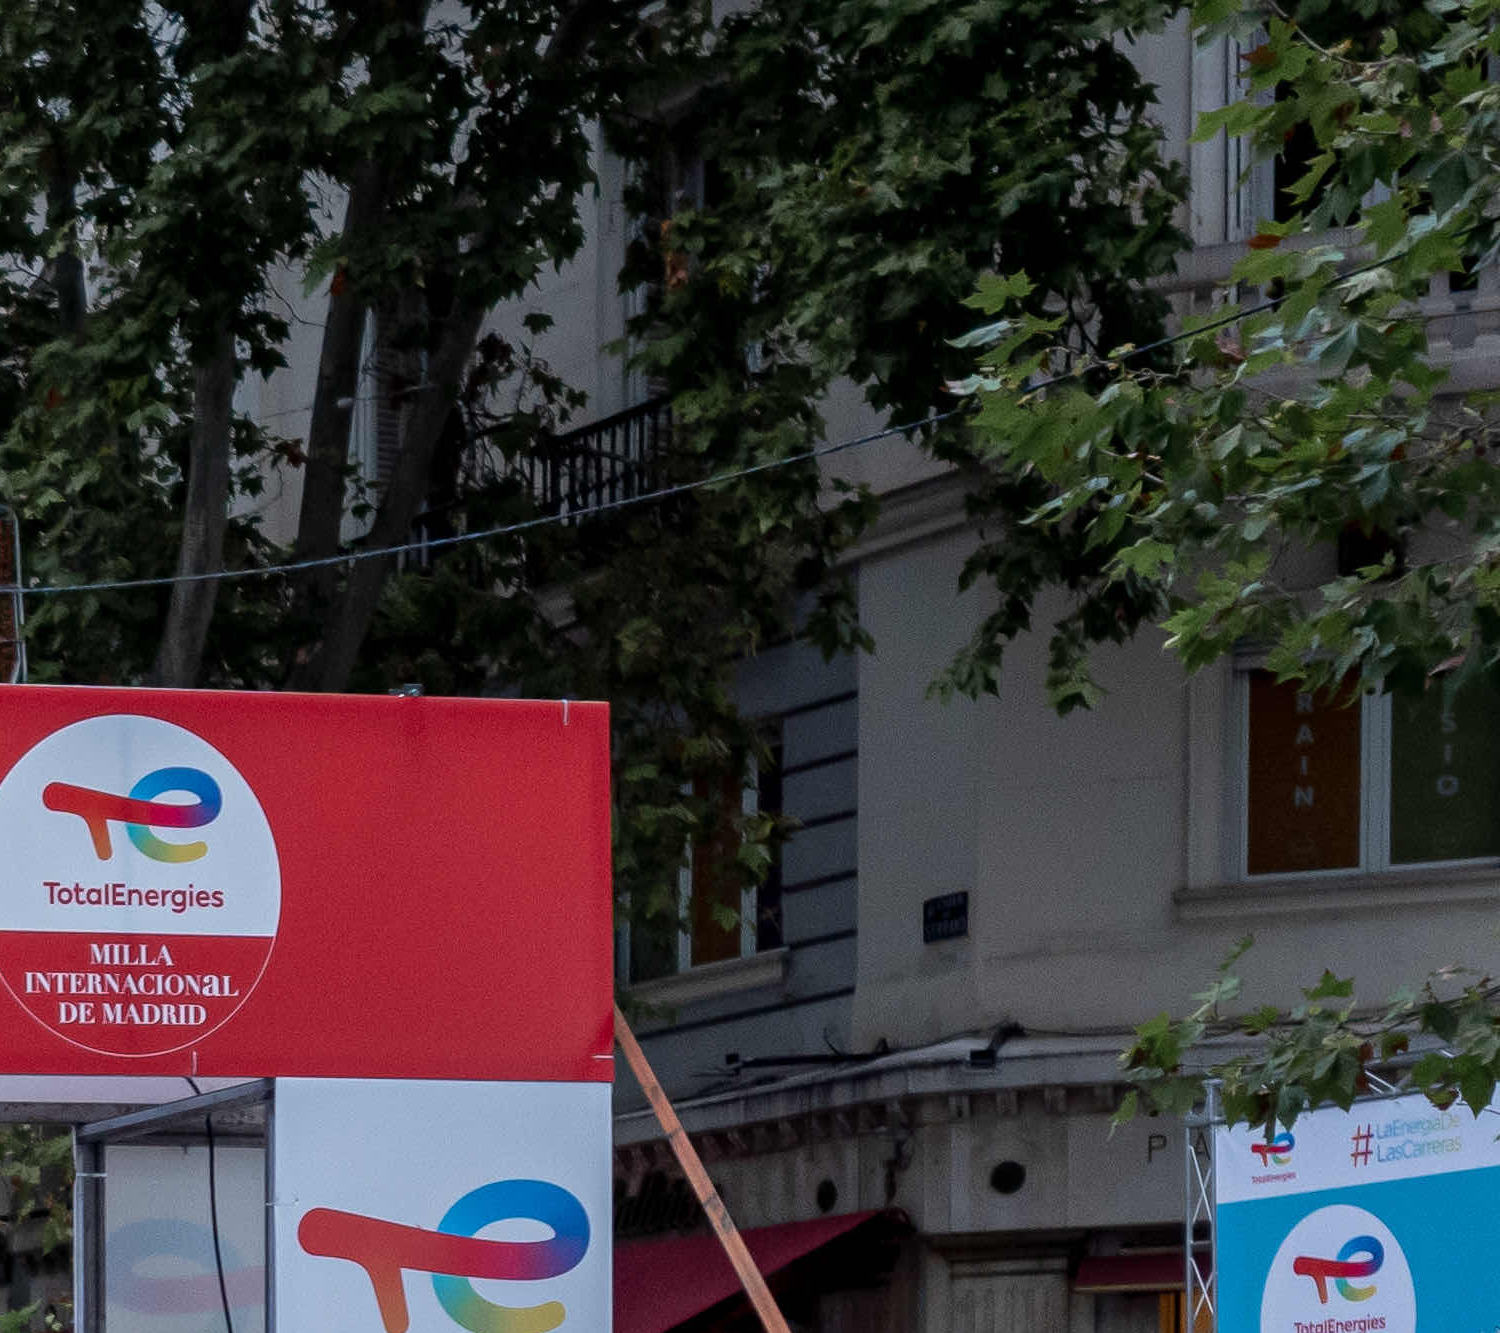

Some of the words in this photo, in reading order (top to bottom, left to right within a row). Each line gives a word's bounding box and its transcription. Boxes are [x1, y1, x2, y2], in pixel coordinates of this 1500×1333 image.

[42, 879, 225, 914] TotalEnergies
[90, 943, 175, 968] MILLA
[58, 1001, 96, 1026] DE
[101, 1001, 208, 1027] MADRID
